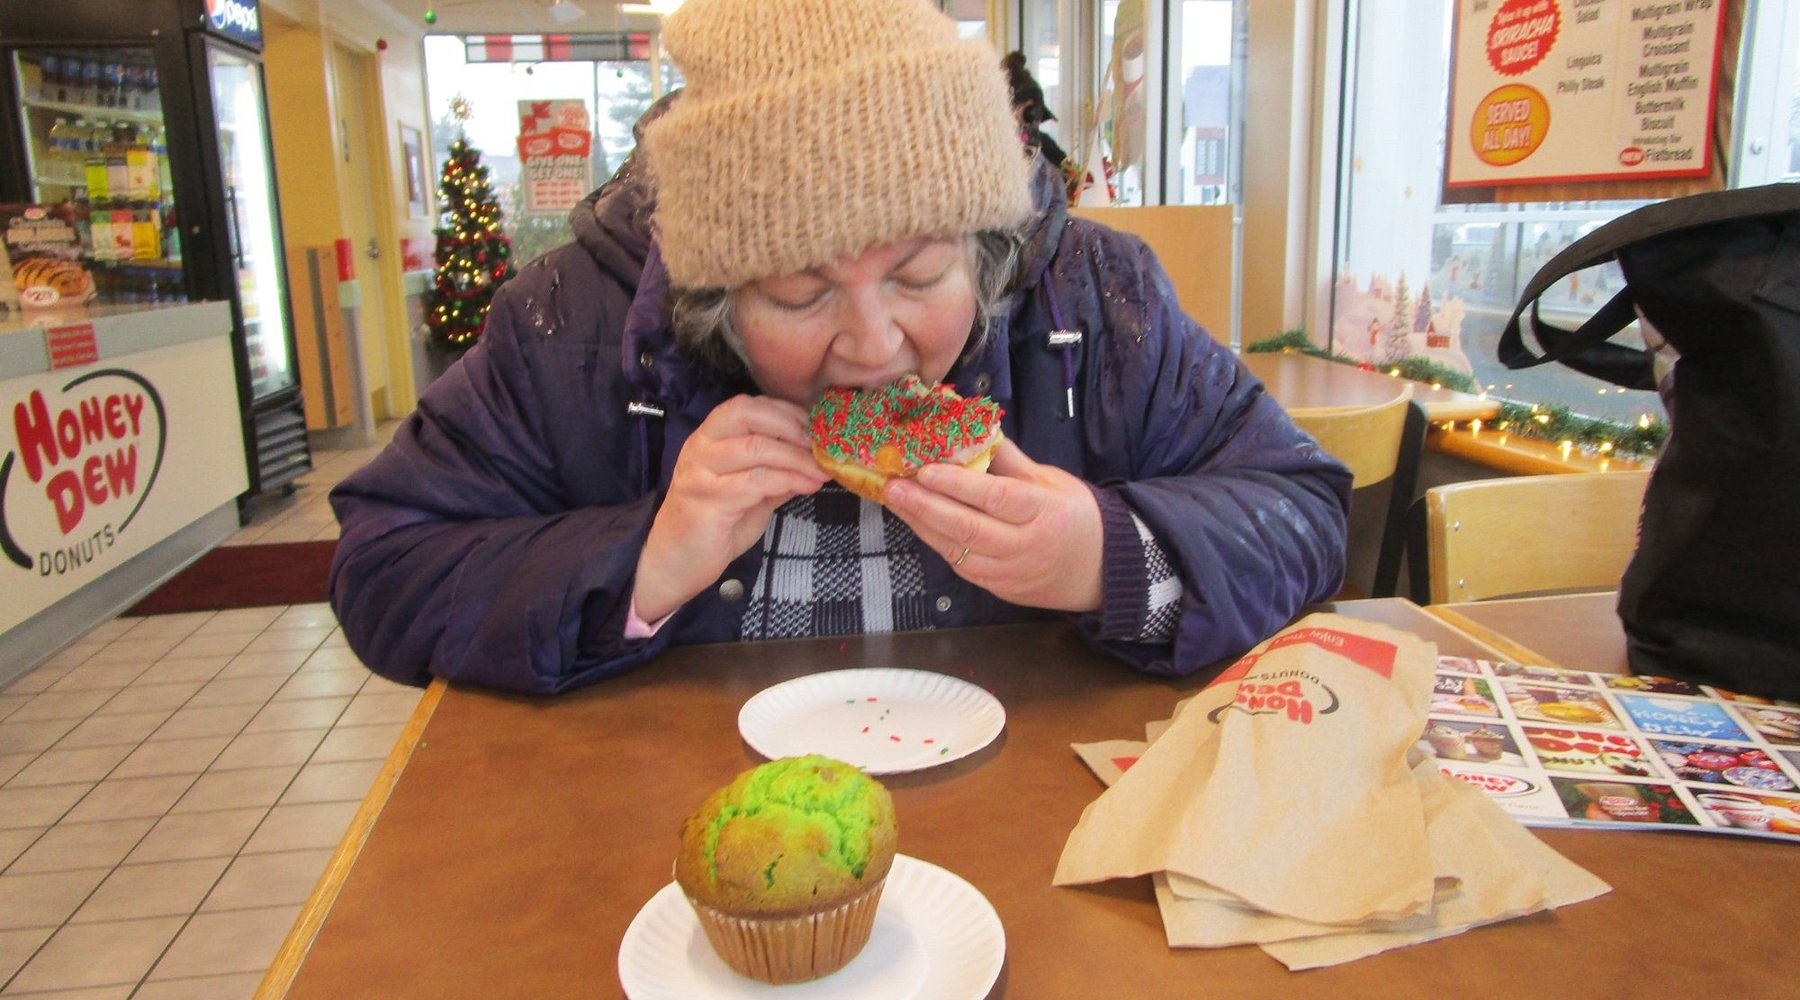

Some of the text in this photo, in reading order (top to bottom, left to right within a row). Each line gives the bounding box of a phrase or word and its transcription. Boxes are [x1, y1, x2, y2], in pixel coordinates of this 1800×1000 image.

[225, 0, 257, 32] pepsi
[1577, 7, 1600, 23] Salad
[1631, 3, 1681, 21] Multigrain
[1491, 13, 1555, 50] SRIRACHA
[1643, 22, 1694, 40] Multigrain
[1501, 39, 1539, 66] SAUCE!
[1643, 40, 1690, 58] Croissant
[1639, 61, 1689, 78] Multigrain
[1557, 77, 1605, 95] Philly Steak
[1627, 76, 1698, 97] English Muffin
[1487, 99, 1531, 125] SERVED
[1635, 97, 1685, 115] Buttermilk
[1641, 116, 1675, 131] Biscuit
[1482, 124, 1532, 151] ALL DAY!
[1646, 146, 1693, 161] Flatbread
[530, 167, 553, 180] GET
[14, 389, 144, 483] HONEY
[45, 444, 138, 536] DEW
[39, 523, 116, 577] DONUTS
[1309, 629, 1344, 647] Enjoy
[1261, 669, 1320, 685] DONUTS
[1631, 709, 1725, 728] HONEY
[1642, 722, 1718, 737] DEW
